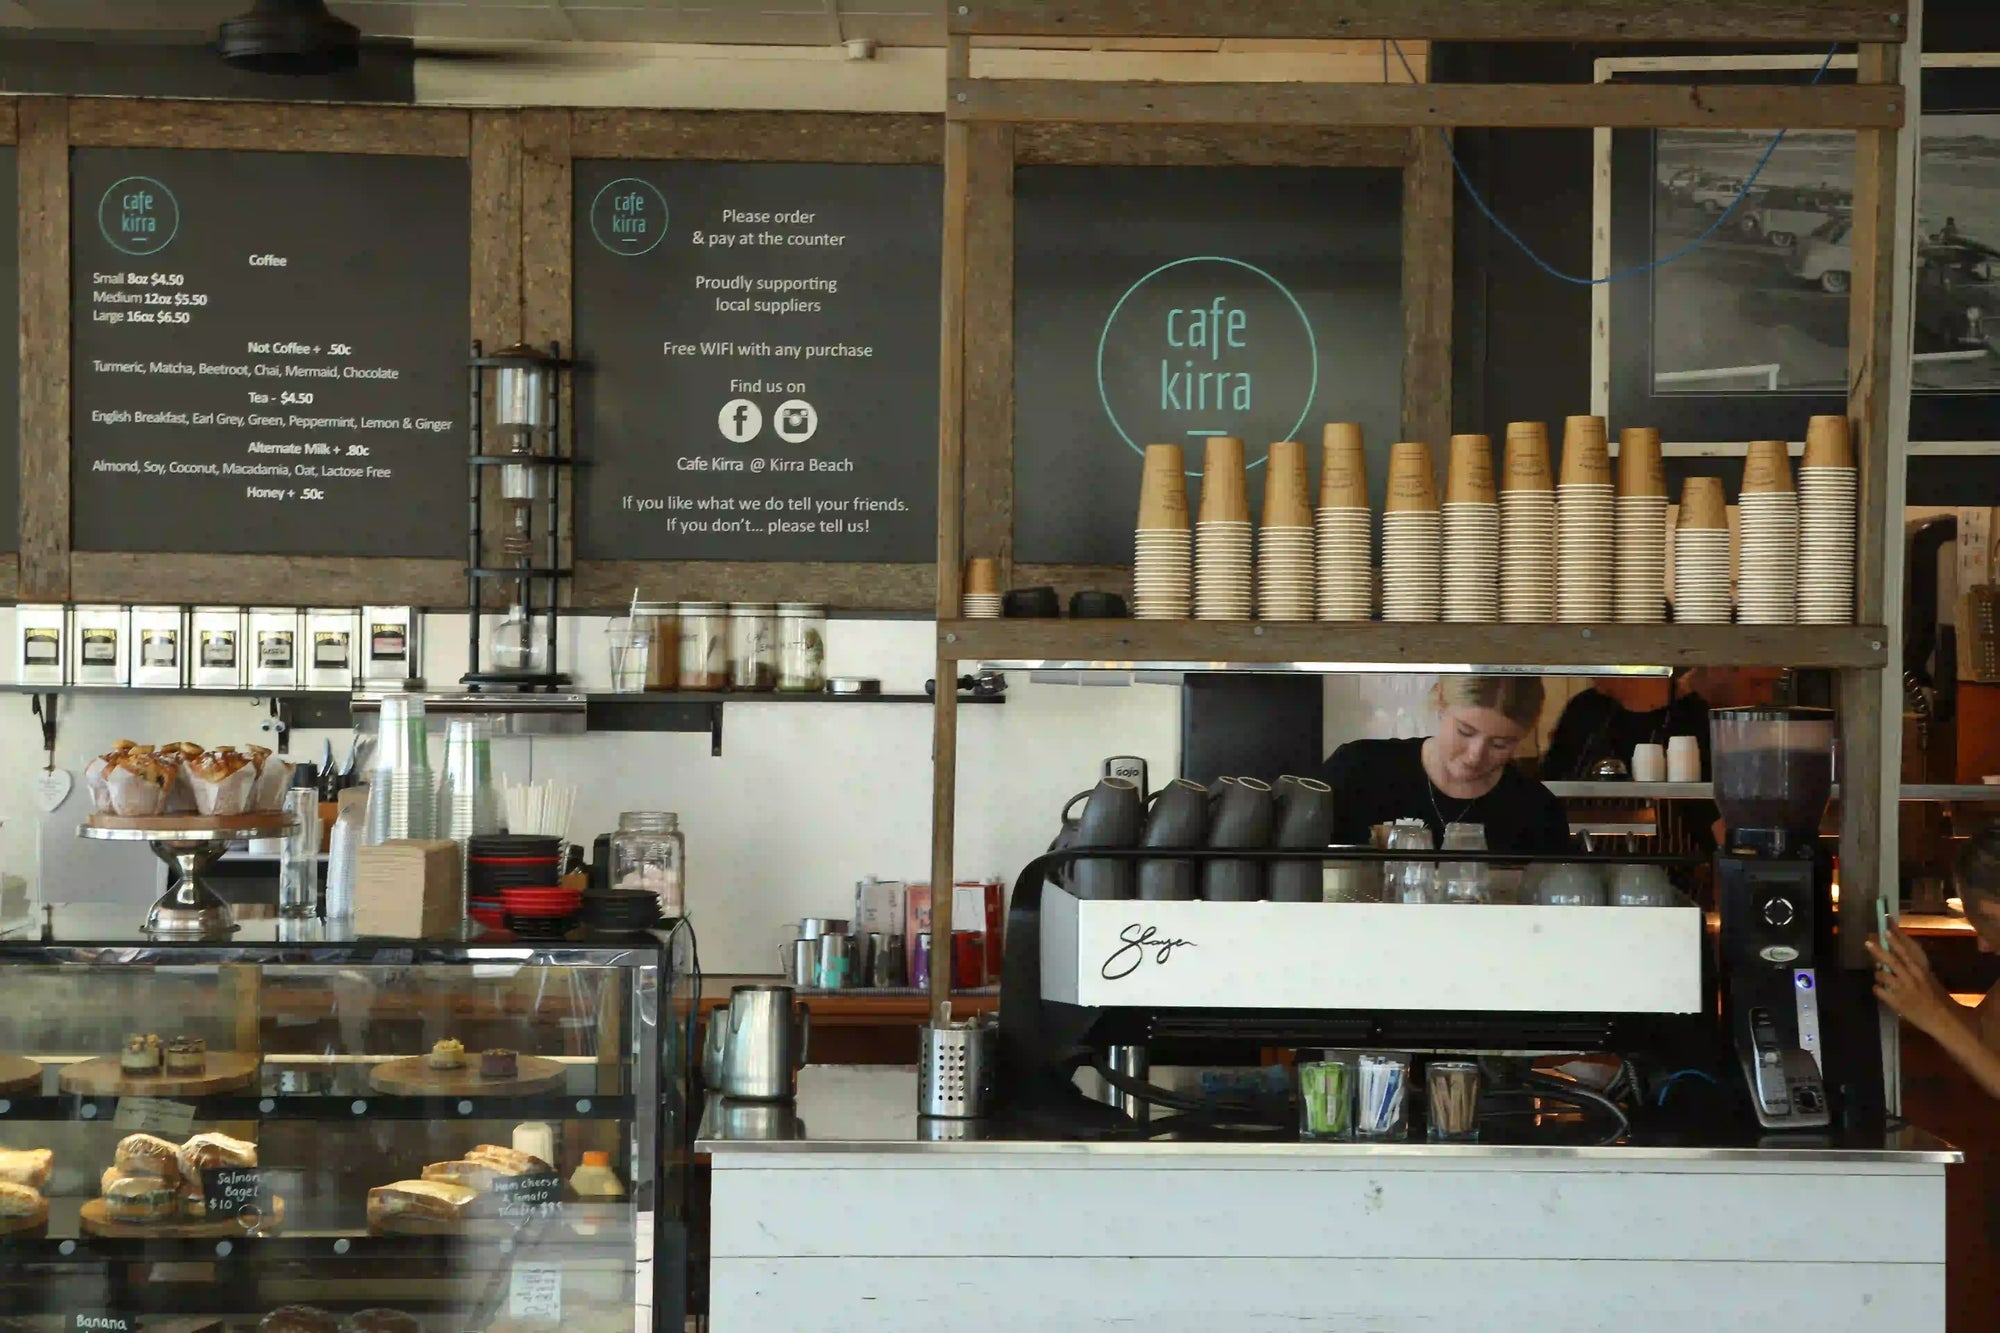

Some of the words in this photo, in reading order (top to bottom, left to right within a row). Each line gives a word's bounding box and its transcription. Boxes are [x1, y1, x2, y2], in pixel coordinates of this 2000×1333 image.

[124, 191, 153, 215] cafe
[614, 192, 643, 217] cafe
[122, 212, 155, 231] kirra
[613, 213, 645, 232] kirra
[723, 209, 770, 222] Please
[775, 210, 815, 223] order
[693, 231, 704, 244] &
[709, 235, 735, 247] pay
[740, 233, 754, 244] at
[758, 232, 783, 245] the
[788, 234, 845, 245] counter
[249, 254, 287, 266] Coffee
[93, 273, 124, 284] Small
[127, 273, 148, 284] 8oz
[151, 273, 184, 286] $4.50
[696, 276, 753, 292] Proudly
[757, 277, 837, 293] supporting
[94, 291, 142, 303] Medium
[144, 293, 172, 304] 12oz
[175, 293, 207, 306] $5.50
[716, 298, 749, 311] local
[754, 298, 821, 314] suppliers
[94, 310, 124, 324] Large
[127, 311, 155, 322] 16oz
[156, 310, 190, 324] $6.50
[1166, 297, 1245, 362] cafe
[248, 342, 270, 353] Not
[273, 342, 310, 354] Coffee
[327, 344, 351, 355] .50c
[664, 342, 696, 355] Free
[700, 342, 733, 355] WIFI
[738, 342, 770, 355] with
[775, 346, 801, 359] any
[806, 343, 872, 359] purchase
[93, 360, 146, 374] Turmeric,
[150, 362, 195, 375] Matcha,
[199, 363, 251, 377] Beetroot,
[254, 364, 282, 377] Chai,
[285, 366, 340, 379] Mermaid,
[343, 367, 399, 379] Chocolate
[731, 380, 761, 392] Find
[767, 383, 782, 392] us
[787, 383, 805, 392] on
[1162, 358, 1250, 410] kirra
[248, 392, 268, 403] Tea
[281, 391, 313, 405] $4.50
[92, 410, 131, 424] English
[135, 411, 189, 425] Breakfast,
[193, 413, 213, 424] Earl
[216, 413, 245, 427] Grey,
[248, 414, 286, 427] Green,
[289, 415, 357, 429] Peppermint,
[361, 417, 399, 428] Lemon
[403, 418, 412, 429] &
[415, 418, 452, 432] Ginger
[248, 442, 302, 454] Alternate
[304, 443, 331, 454] Milk
[332, 446, 341, 454] +
[346, 445, 369, 456] .80c
[93, 460, 141, 473] Almond,
[144, 461, 166, 475] Soy,
[170, 462, 219, 475] Coconut,
[223, 463, 291, 477] Macadamia,
[295, 465, 318, 477] Oat,
[322, 466, 363, 477] Lactose
[367, 466, 391, 477] Free
[677, 457, 708, 470] Cafe
[712, 457, 743, 471] Kirra
[751, 458, 765, 473] @
[771, 458, 804, 471] Kirra
[810, 458, 853, 471] Beach
[247, 487, 285, 500] Honey
[300, 488, 324, 499] .50c
[623, 496, 632, 508] If
[637, 499, 663, 511] you
[669, 496, 693, 509] like
[697, 496, 734, 509] what
[739, 500, 760, 510] we
[765, 497, 783, 510] do
[788, 497, 811, 510] tell
[816, 501, 849, 513] your
[853, 497, 908, 511] friends.
[667, 518, 679, 531] If
[680, 522, 707, 534] you
[768, 519, 815, 535] please
[820, 519, 842, 532] tell
[848, 520, 869, 532] us!
[218, 1171, 261, 1185] Salmon
[225, 1186, 258, 1202] Bagel
[209, 1198, 233, 1210] $10
[76, 1314, 127, 1330] Banana
